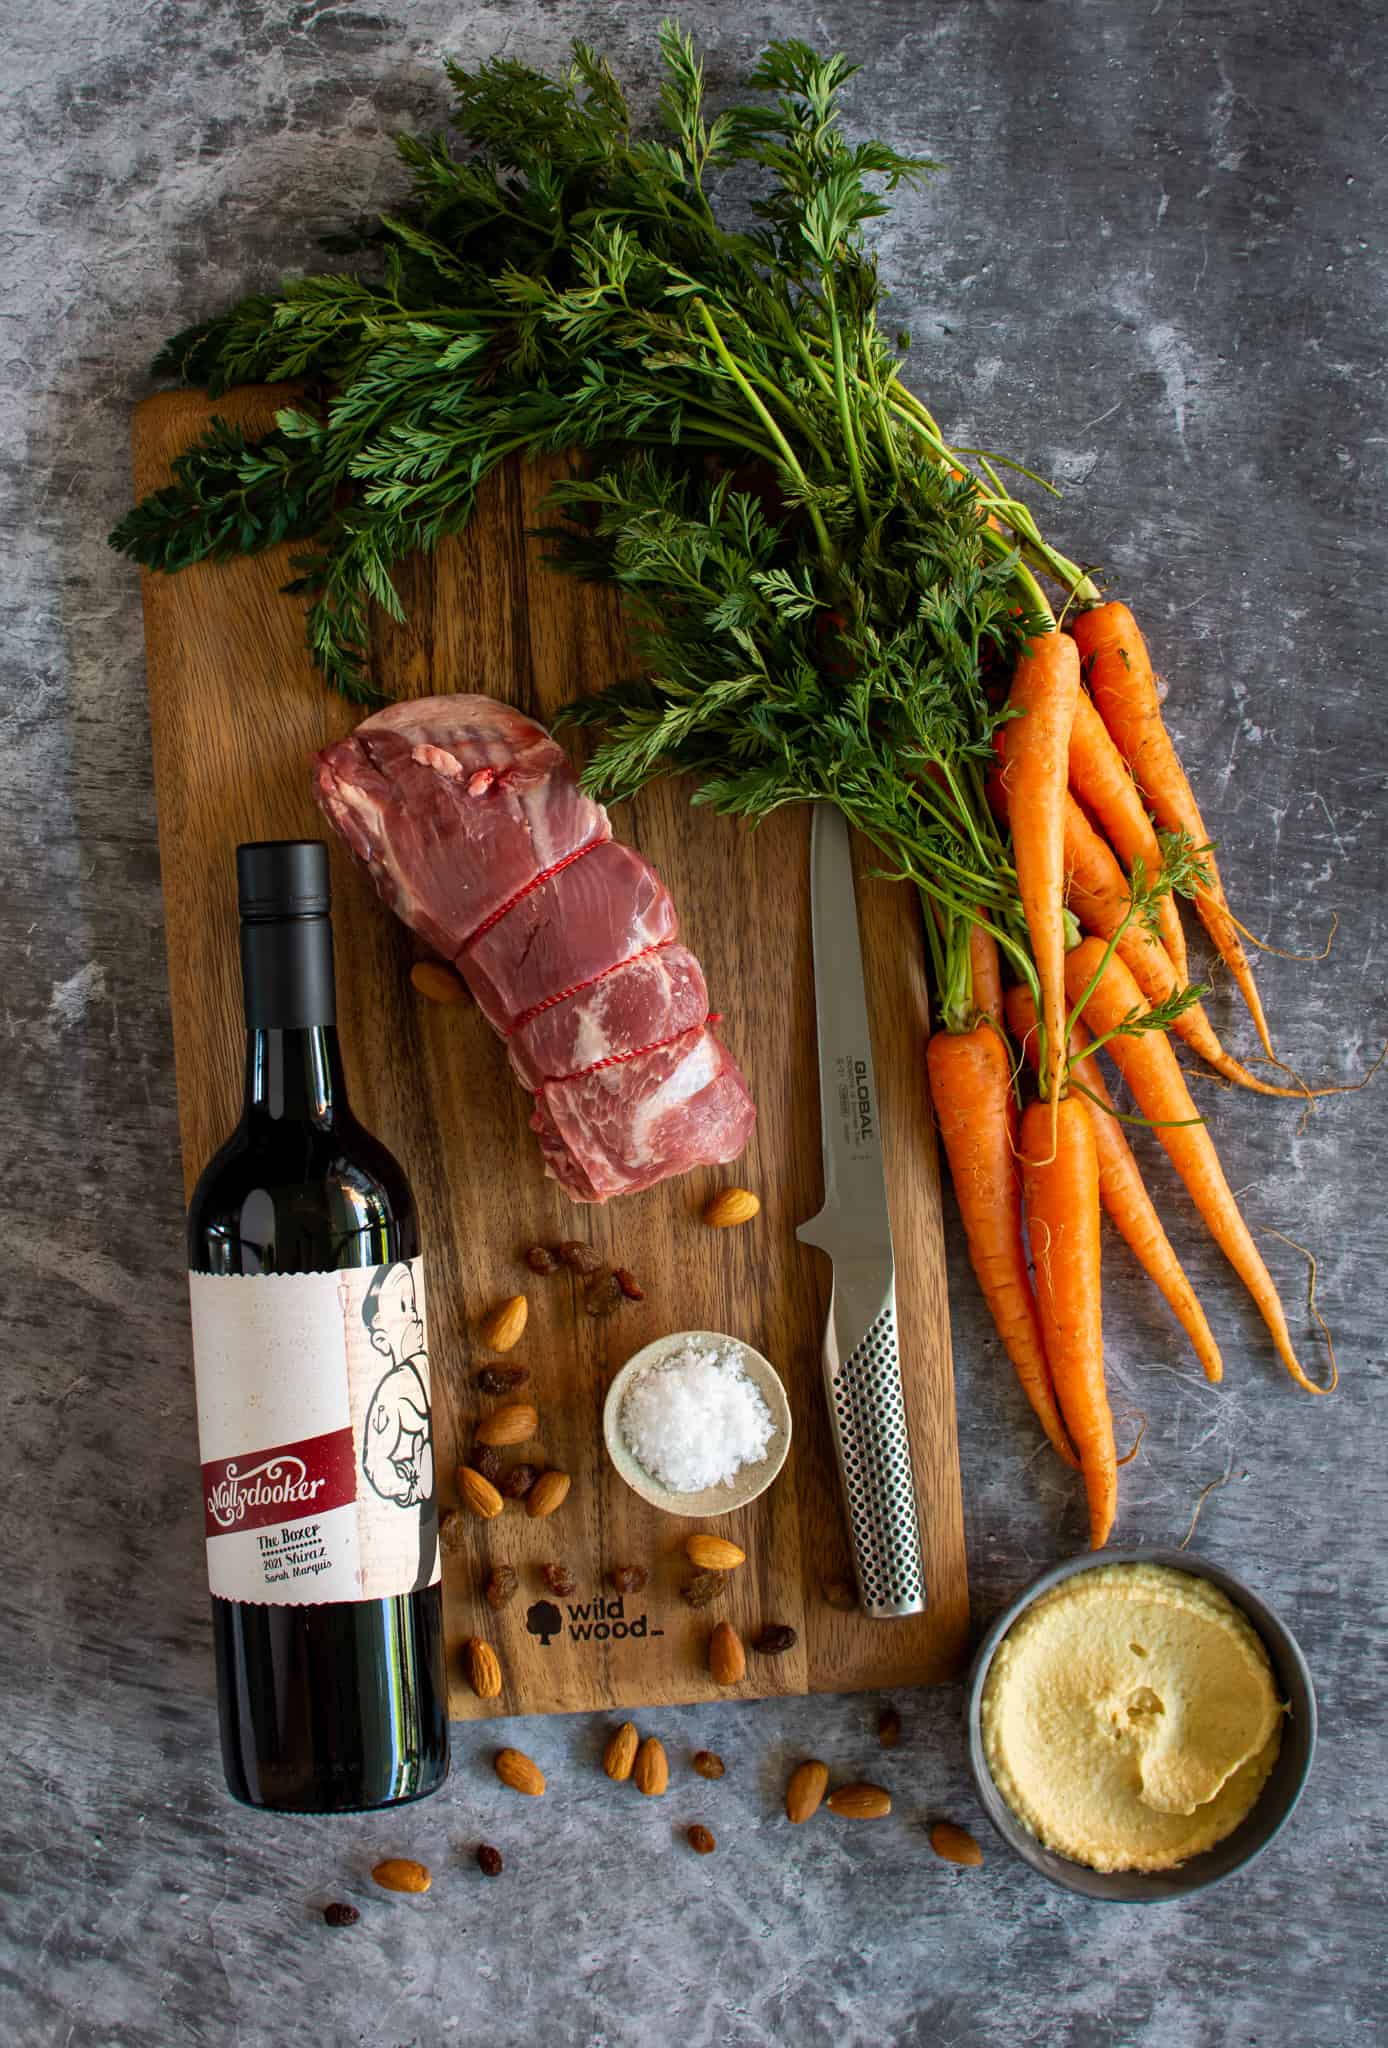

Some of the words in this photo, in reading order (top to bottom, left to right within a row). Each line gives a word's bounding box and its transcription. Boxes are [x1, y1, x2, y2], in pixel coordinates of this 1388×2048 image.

[854, 1061, 873, 1141] GLOBAL
[257, 1535, 279, 1550] The
[281, 1524, 320, 1545] Boxer
[263, 1559, 283, 1571] 2021
[286, 1547, 328, 1566] Shiraz
[264, 1570, 290, 1584] Sarah
[292, 1560, 333, 1578] Marquis
[568, 1596, 625, 1621] wild
